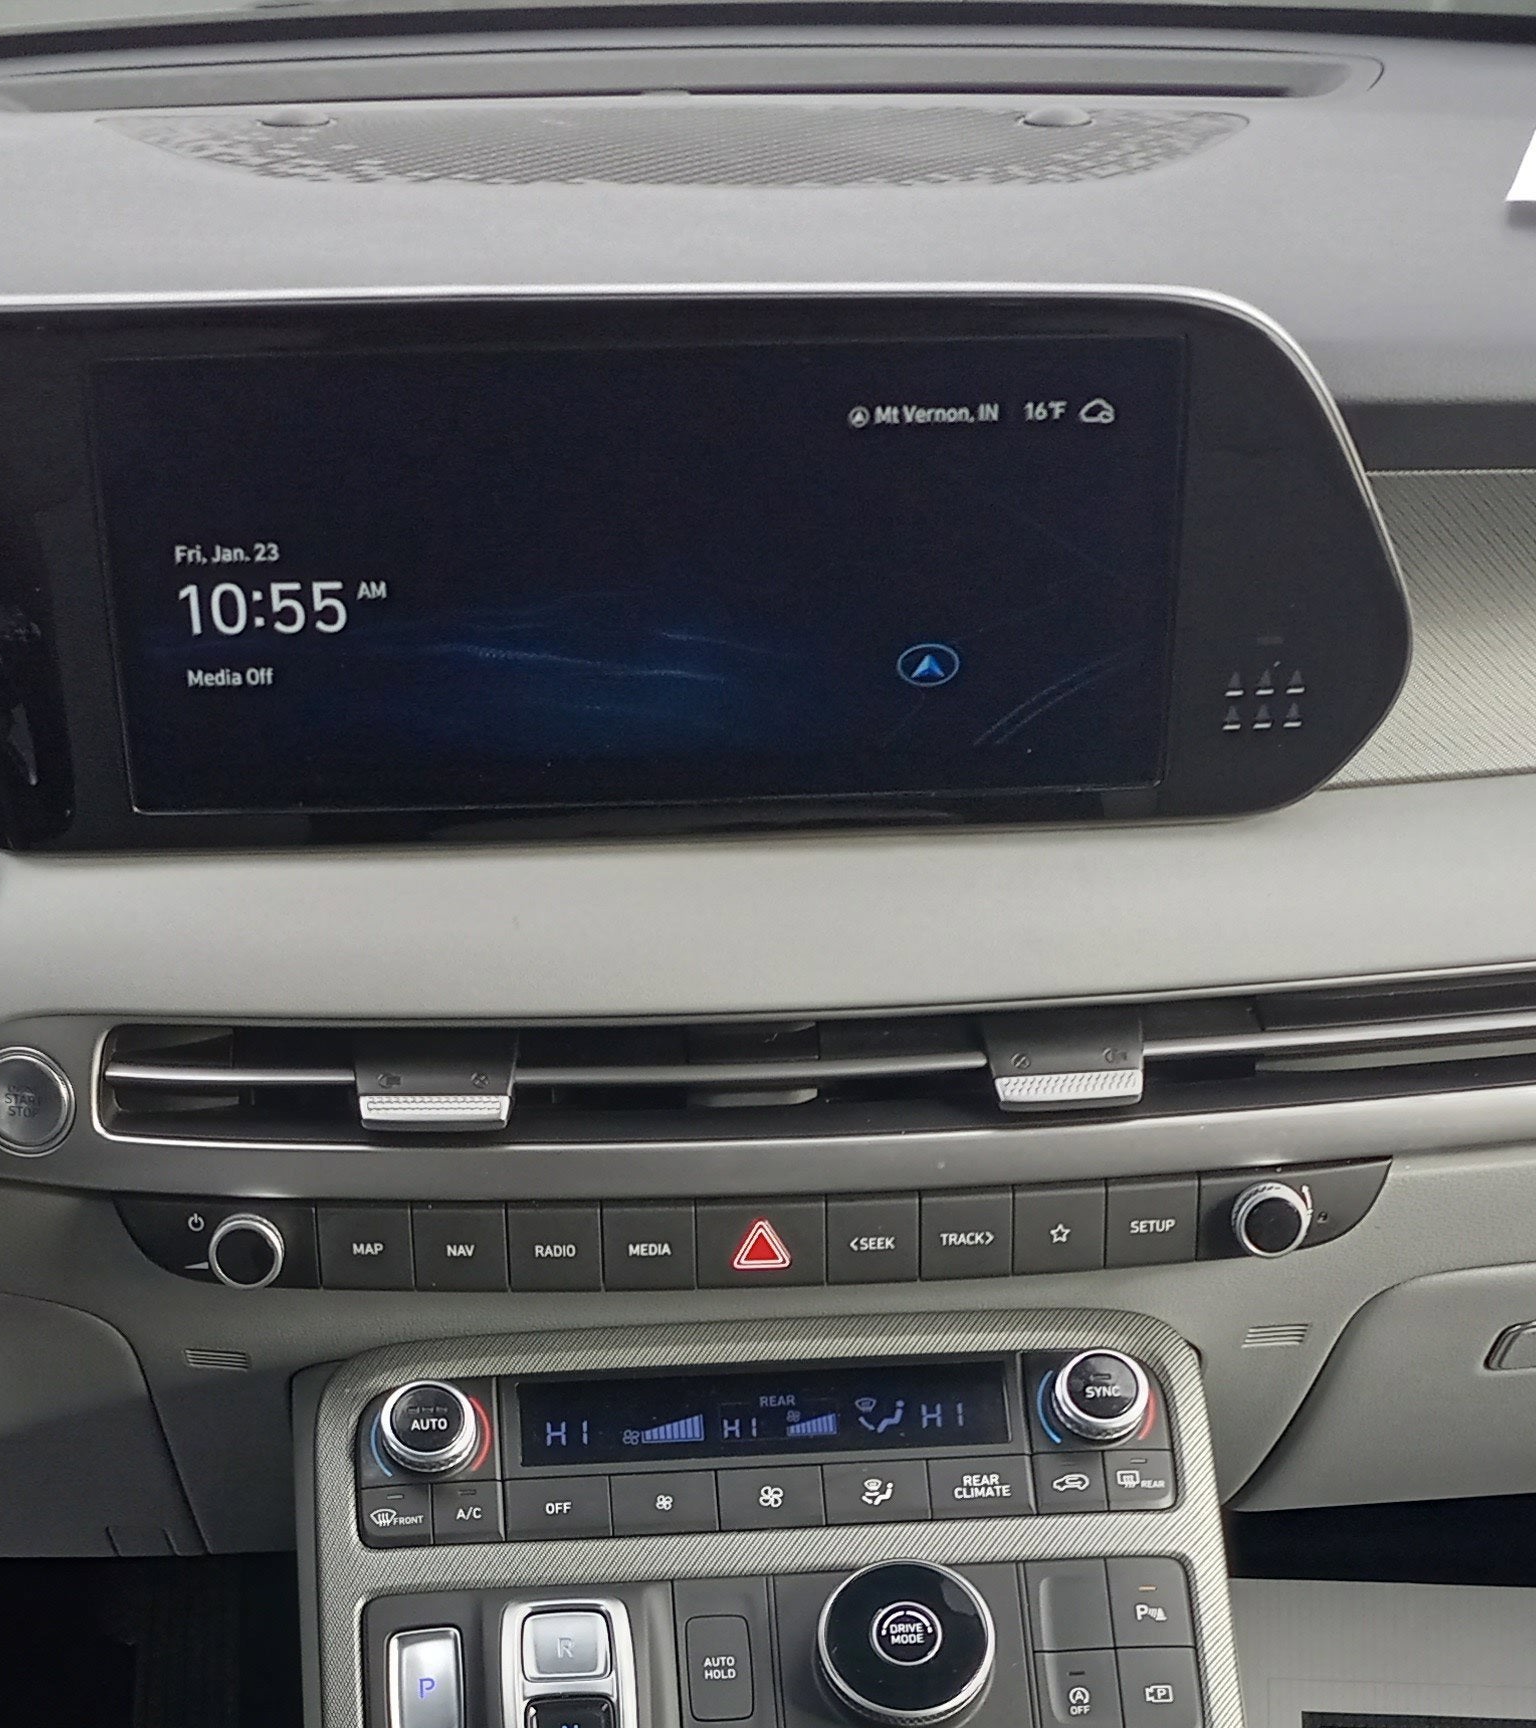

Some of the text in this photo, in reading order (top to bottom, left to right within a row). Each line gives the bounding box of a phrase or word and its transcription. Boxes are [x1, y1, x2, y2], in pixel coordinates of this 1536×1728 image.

[874, 405, 900, 424] Mt
[978, 403, 999, 422] IN
[174, 543, 280, 565] Fri, Jan. 23
[178, 581, 387, 636] 10:55 AM
[187, 667, 274, 687] Media Off
[1130, 1218, 1176, 1235] SETUP
[352, 1242, 384, 1256] MAP
[446, 1244, 475, 1258] NAV
[534, 1244, 576, 1258] RADIO
[628, 1243, 672, 1257] MEDIA
[1084, 1385, 1121, 1398] SYNC
[759, 1395, 796, 1407] REAR
[410, 1417, 448, 1431] AUTO
[962, 1474, 999, 1486] REAR
[1140, 1480, 1165, 1488] REAR
[953, 1484, 1011, 1499] CLIMATE
[456, 1507, 482, 1520] A/C
[545, 1502, 572, 1514] OFF
[392, 1514, 424, 1526] FRONT
[889, 1622, 923, 1635] DRIVE
[890, 1633, 925, 1645] MODE
[556, 1637, 574, 1659] R
[703, 1656, 735, 1668] AUTO
[704, 1667, 736, 1679] HOLD
[419, 1678, 436, 1699] P
[1069, 1704, 1090, 1715] OFF
